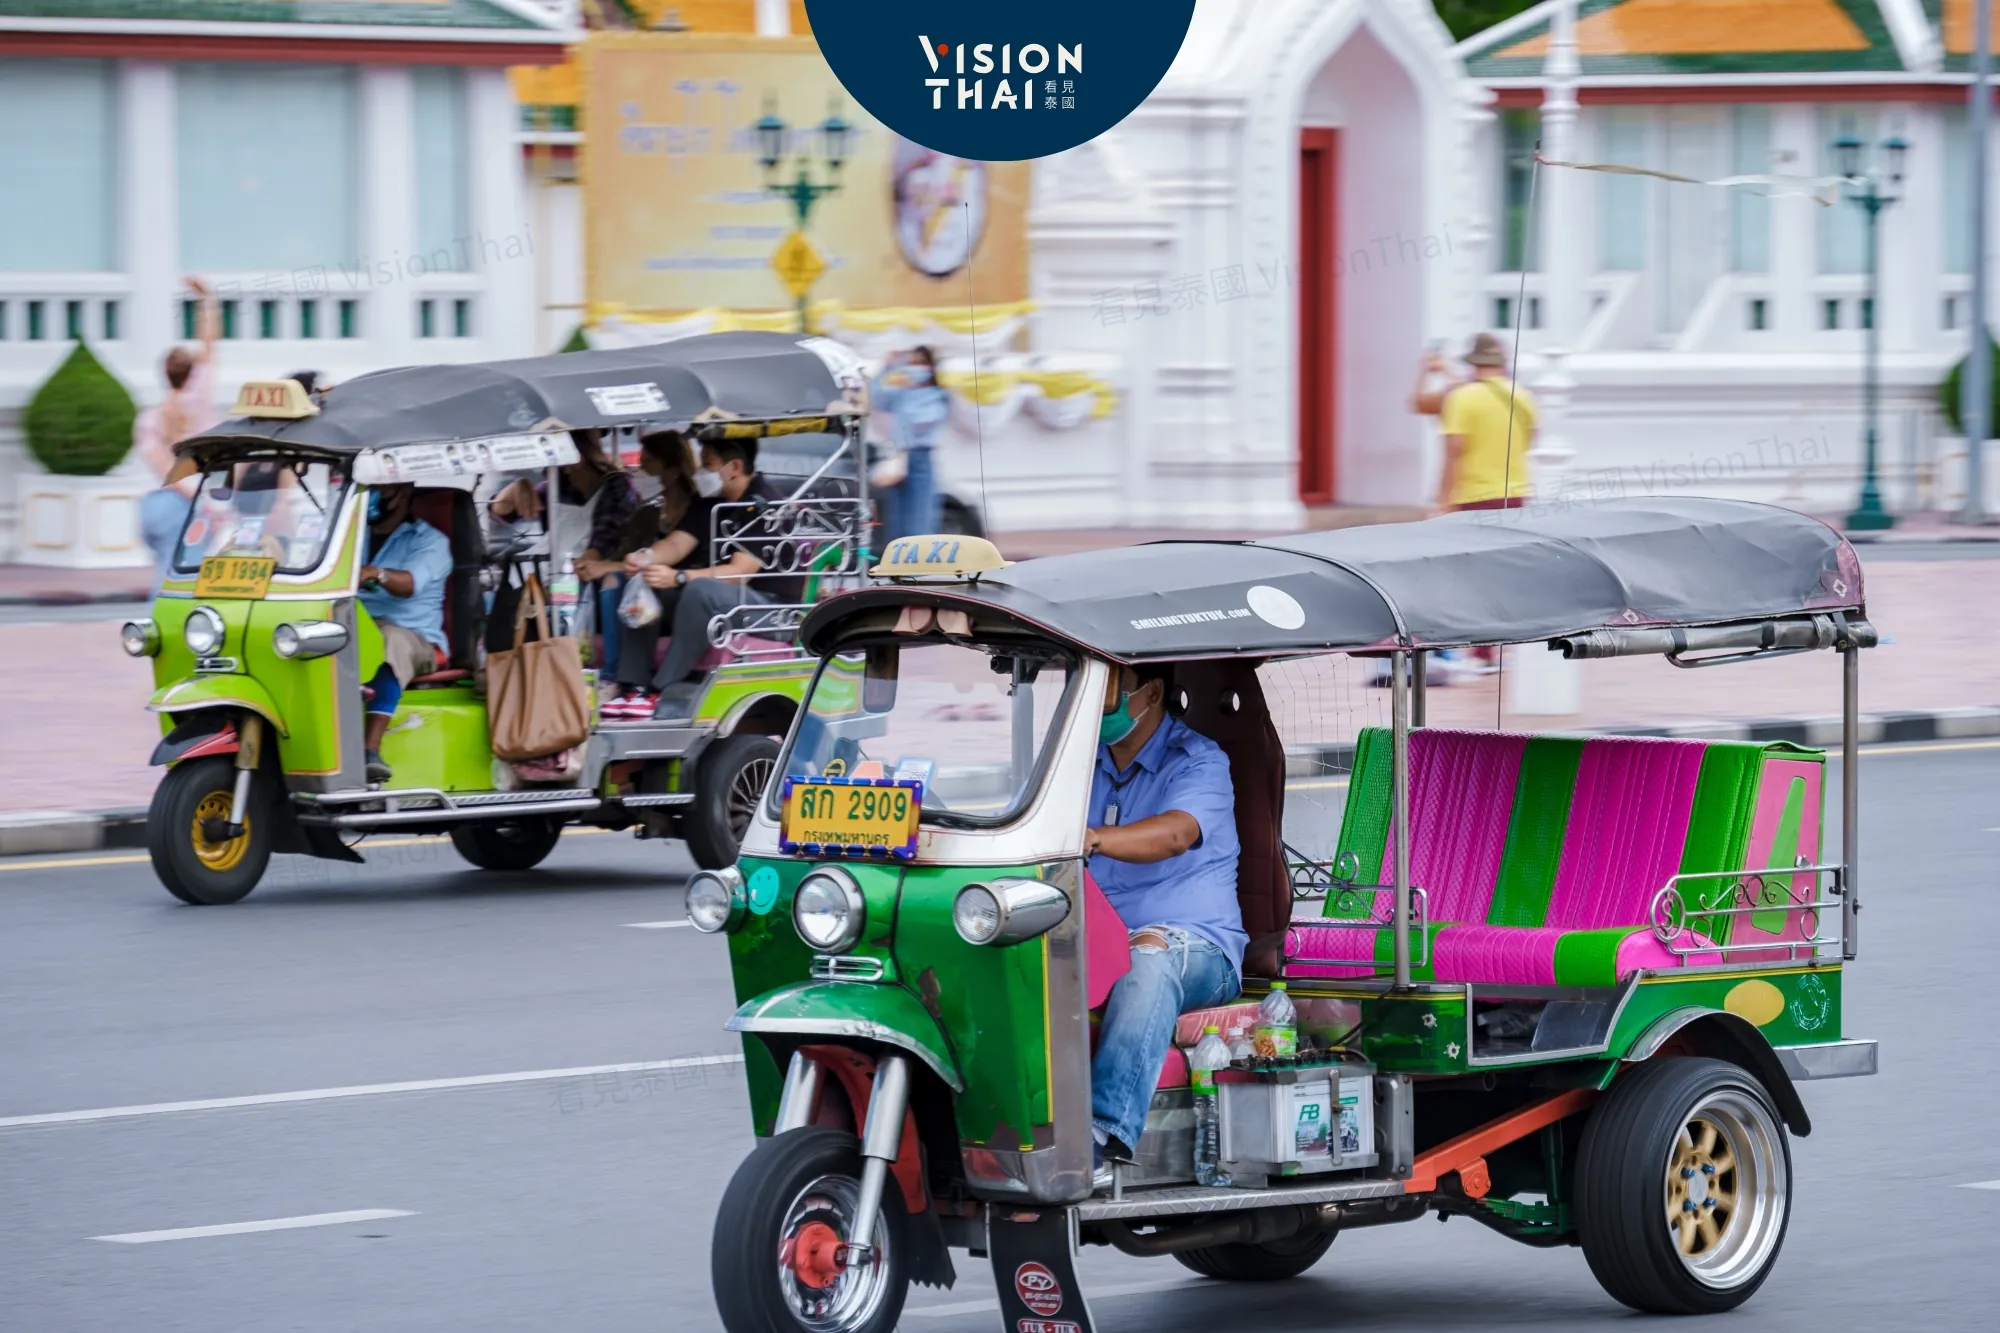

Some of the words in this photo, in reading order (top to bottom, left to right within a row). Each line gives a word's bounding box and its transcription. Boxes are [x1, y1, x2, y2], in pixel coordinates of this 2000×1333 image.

[244, 386, 285, 407] TAXI
[890, 541, 960, 564] TAXI
[231, 561, 269, 580] 1994
[801, 786, 835, 819] สก
[848, 790, 907, 821] 2909
[803, 830, 889, 845] กรงเทพมหานคร
[1299, 1104, 1320, 1120] FB
[1028, 1275, 1048, 1288] PY
